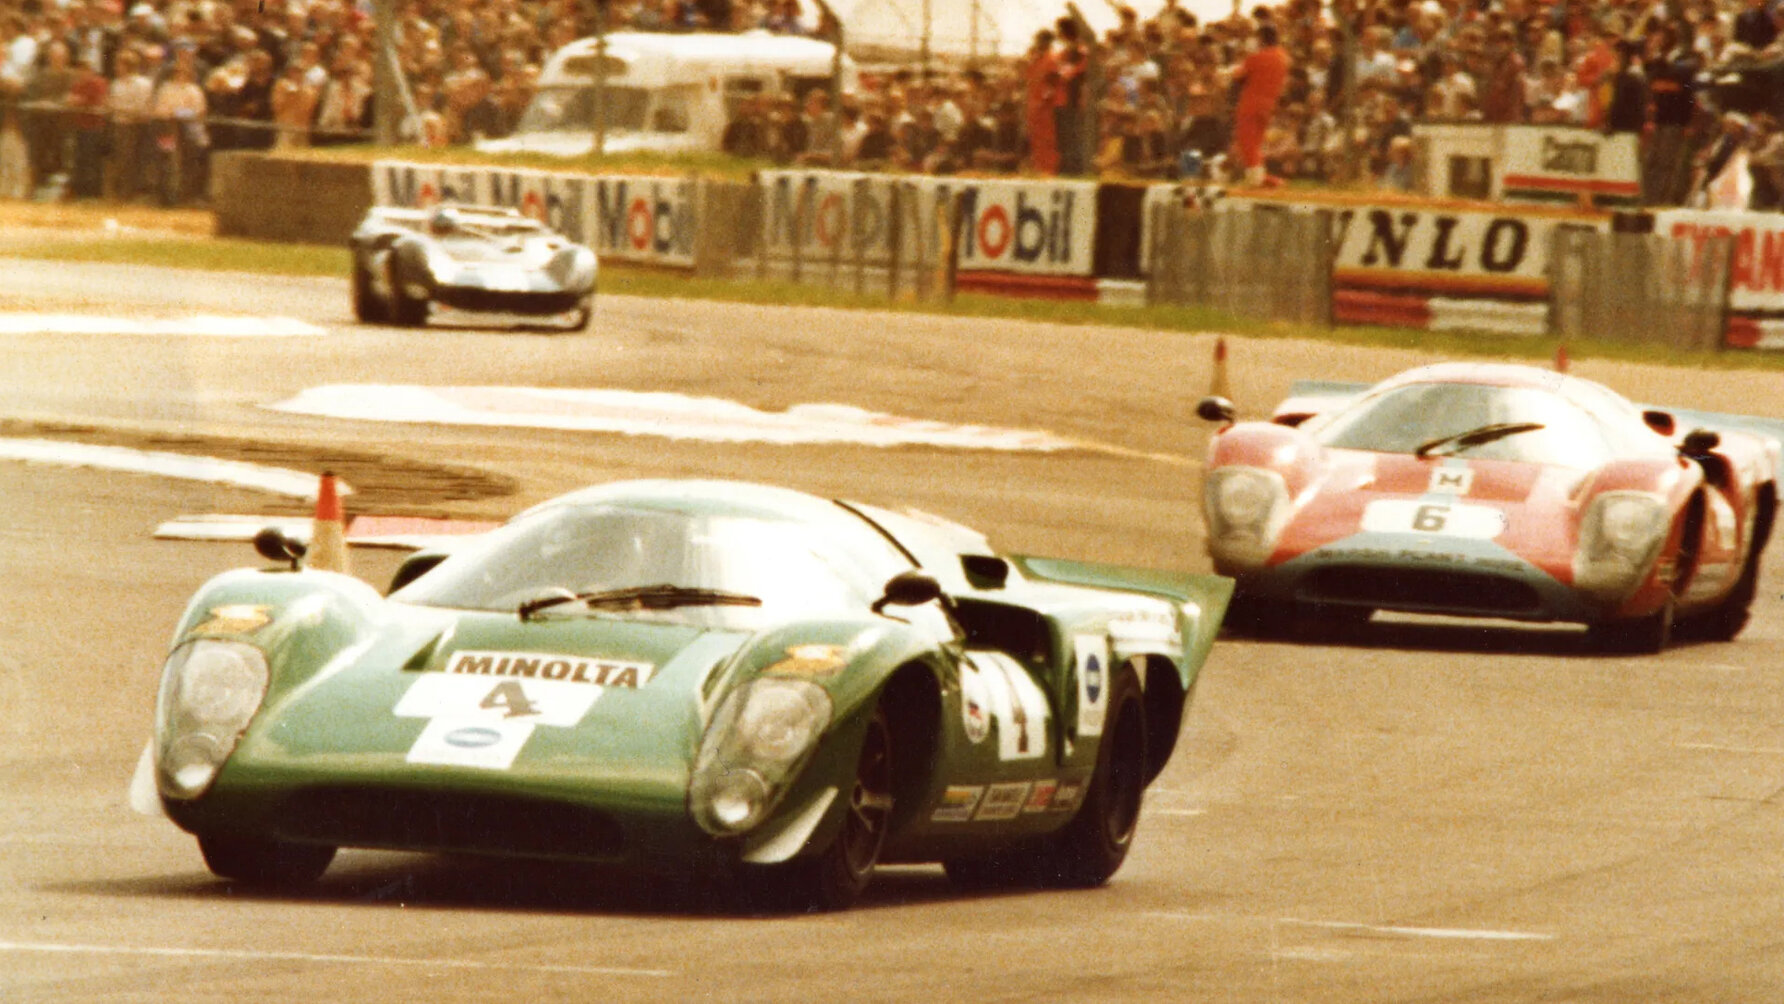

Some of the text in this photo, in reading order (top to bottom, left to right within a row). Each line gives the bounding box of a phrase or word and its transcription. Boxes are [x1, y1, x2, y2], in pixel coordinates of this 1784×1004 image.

[1411, 504, 1451, 532] 6
[452, 653, 640, 690] MINOLTA
[478, 678, 543, 719] 4
